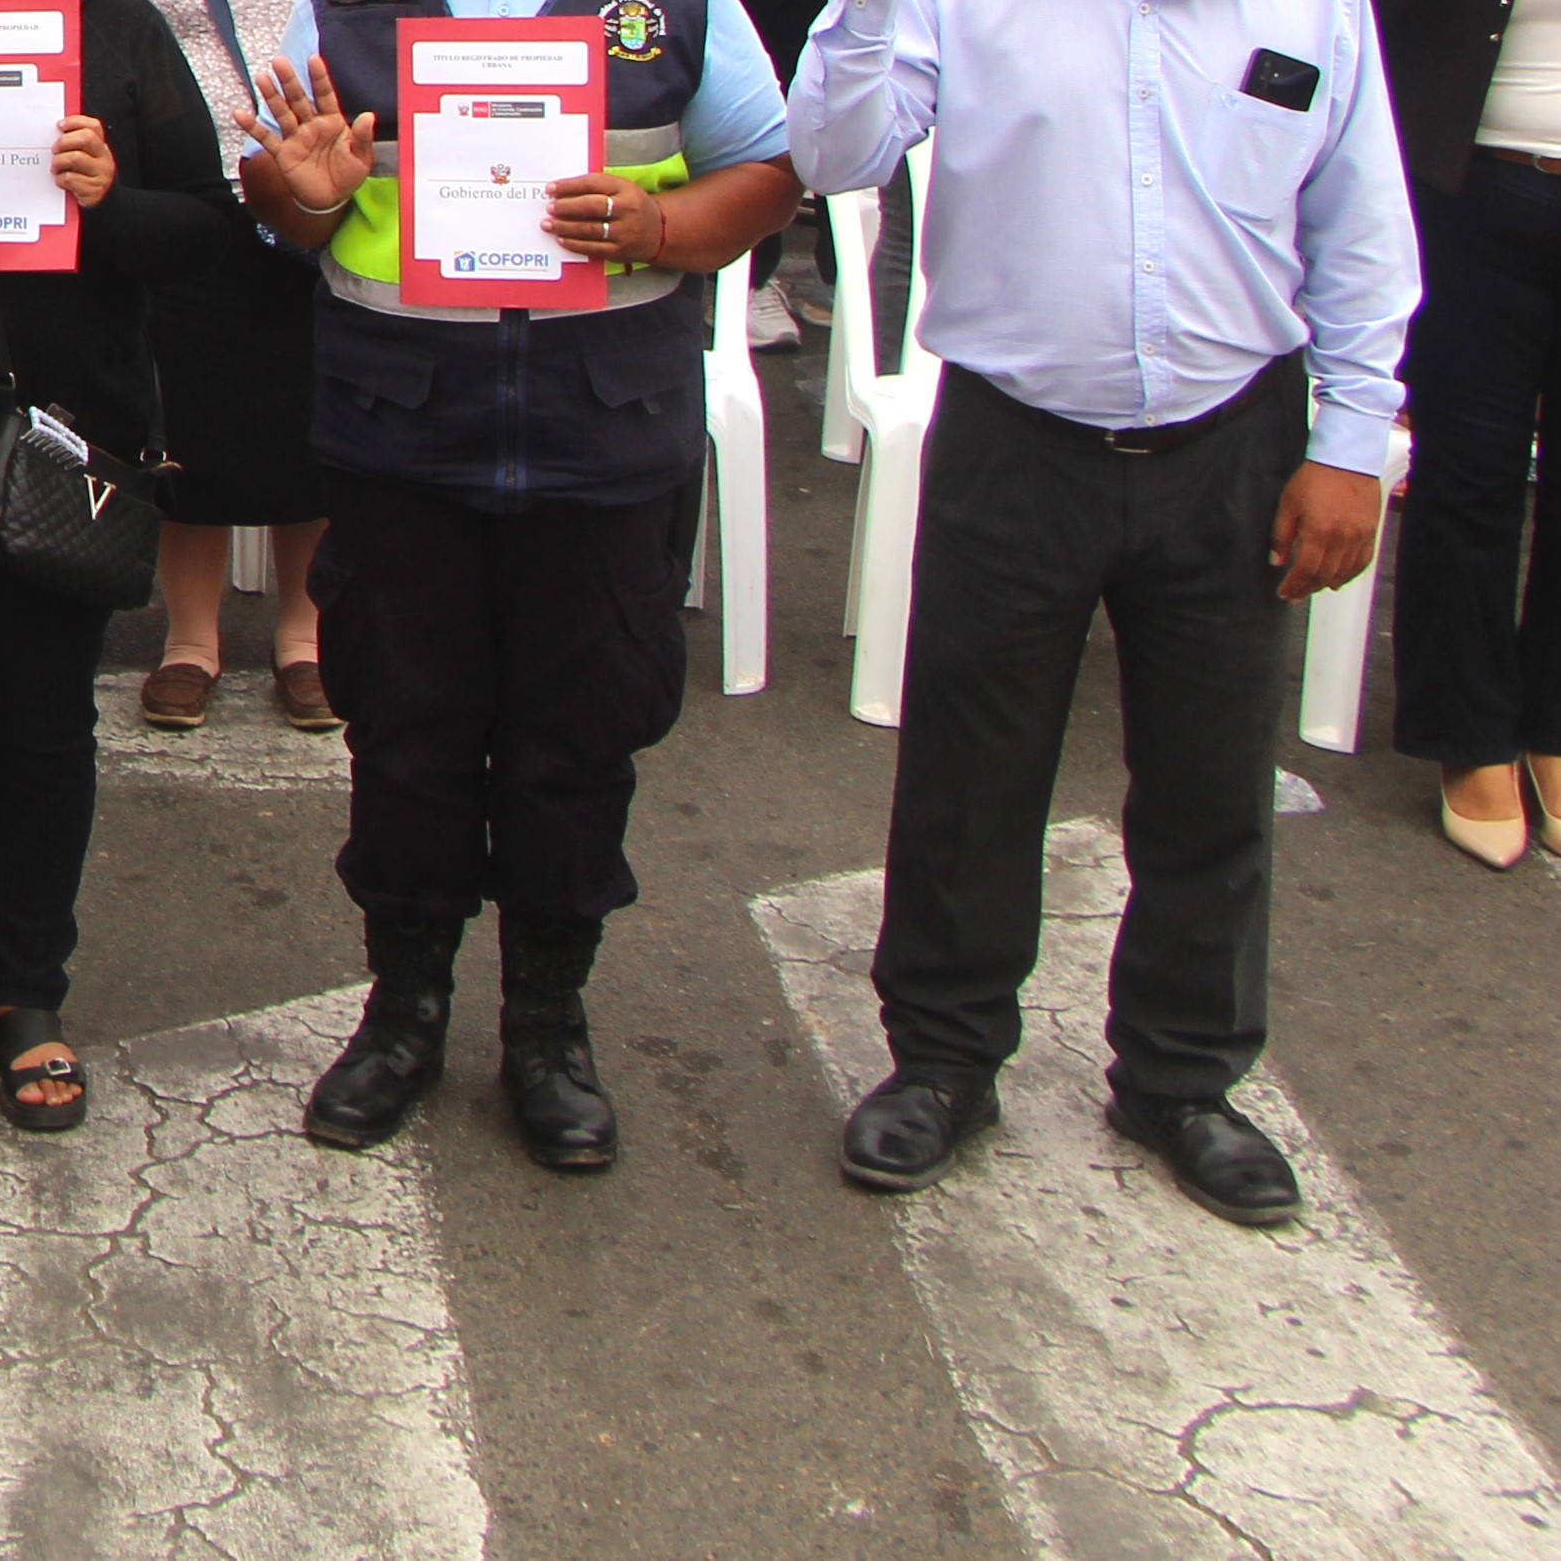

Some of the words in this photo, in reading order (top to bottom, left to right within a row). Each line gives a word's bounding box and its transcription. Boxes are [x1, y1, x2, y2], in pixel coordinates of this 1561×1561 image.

[10, 153, 41, 166] Perú
[439, 185, 503, 201] Gobierno
[506, 186, 527, 200] del
[531, 187, 553, 201] Pe
[477, 251, 549, 267] COFOPRI
